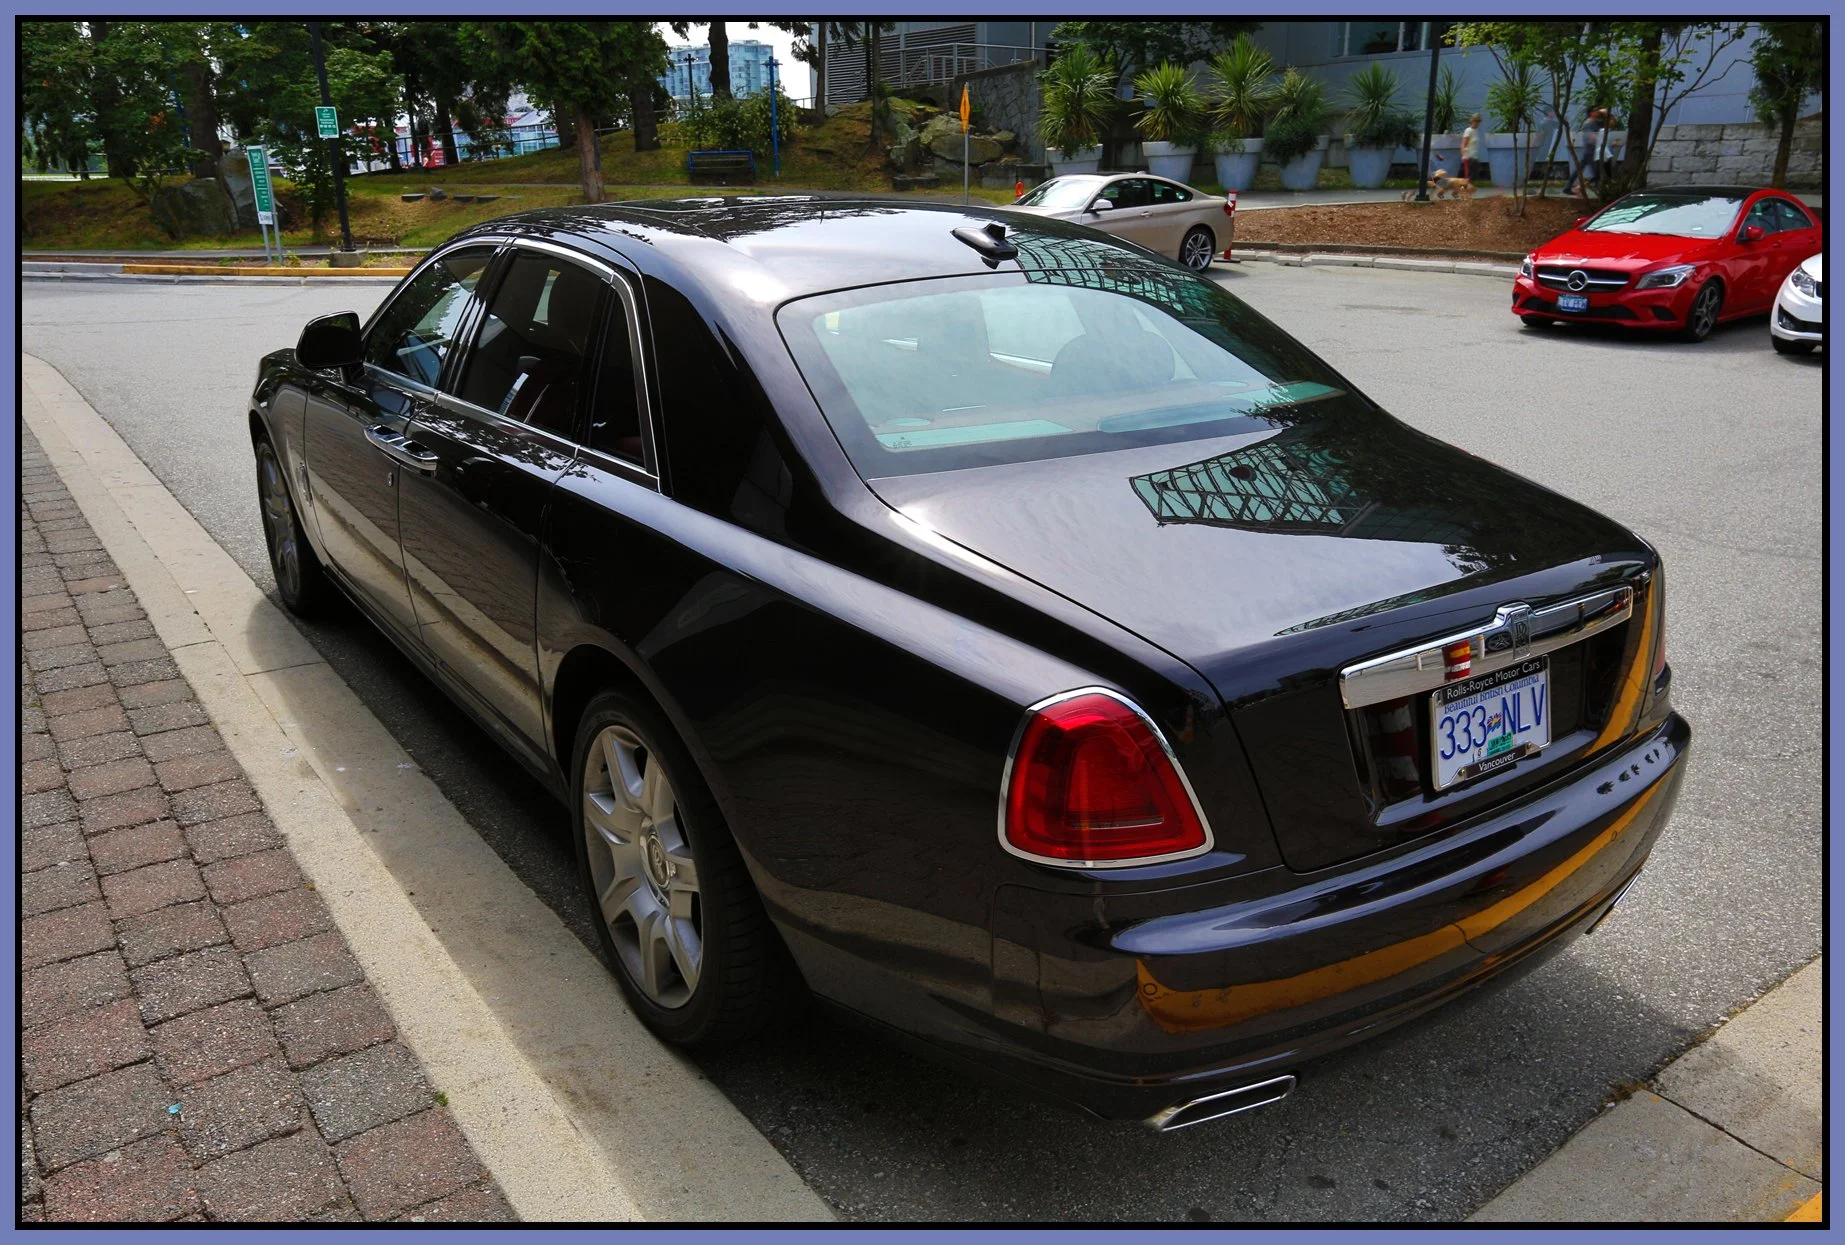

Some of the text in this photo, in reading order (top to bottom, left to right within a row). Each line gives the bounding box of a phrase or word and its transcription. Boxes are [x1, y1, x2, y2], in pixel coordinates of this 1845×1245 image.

[1444, 675, 1539, 714] Beautiful British Columbia
[1447, 661, 1540, 699] Rolls-Royce Motor Cars
[1440, 682, 1545, 760] 333 NLV
[1479, 752, 1515, 771] Vancouver
